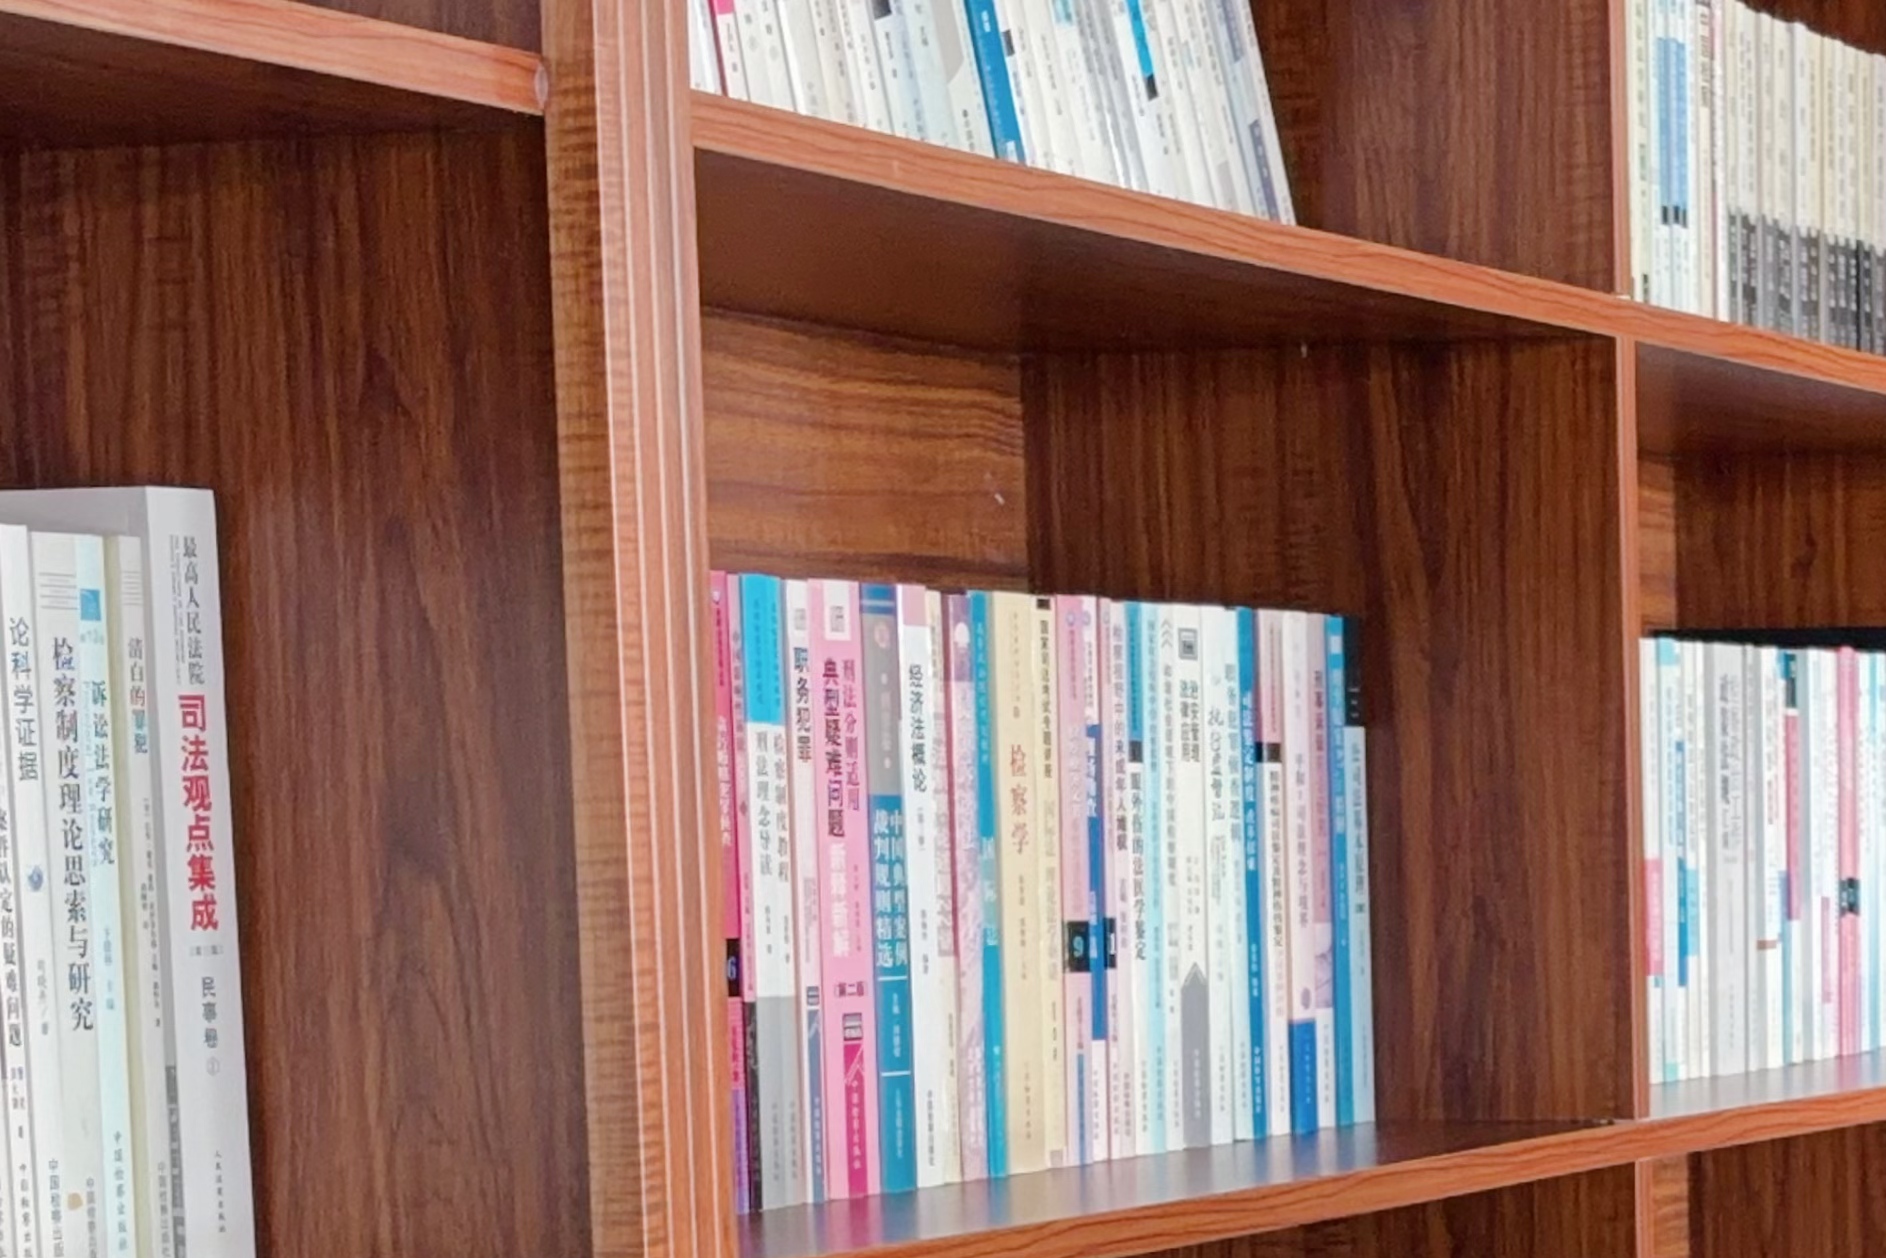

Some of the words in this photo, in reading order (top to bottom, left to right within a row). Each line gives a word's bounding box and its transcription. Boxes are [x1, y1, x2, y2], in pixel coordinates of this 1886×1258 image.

[183, 536, 205, 685] 最高人民法院
[9, 617, 38, 781] 论科学证据
[91, 680, 115, 866] 诉讼法学研究
[52, 636, 93, 1031] 检察制度理论思索与研究
[178, 694, 219, 931] 司法观点集成
[1010, 743, 1029, 854] 检察学
